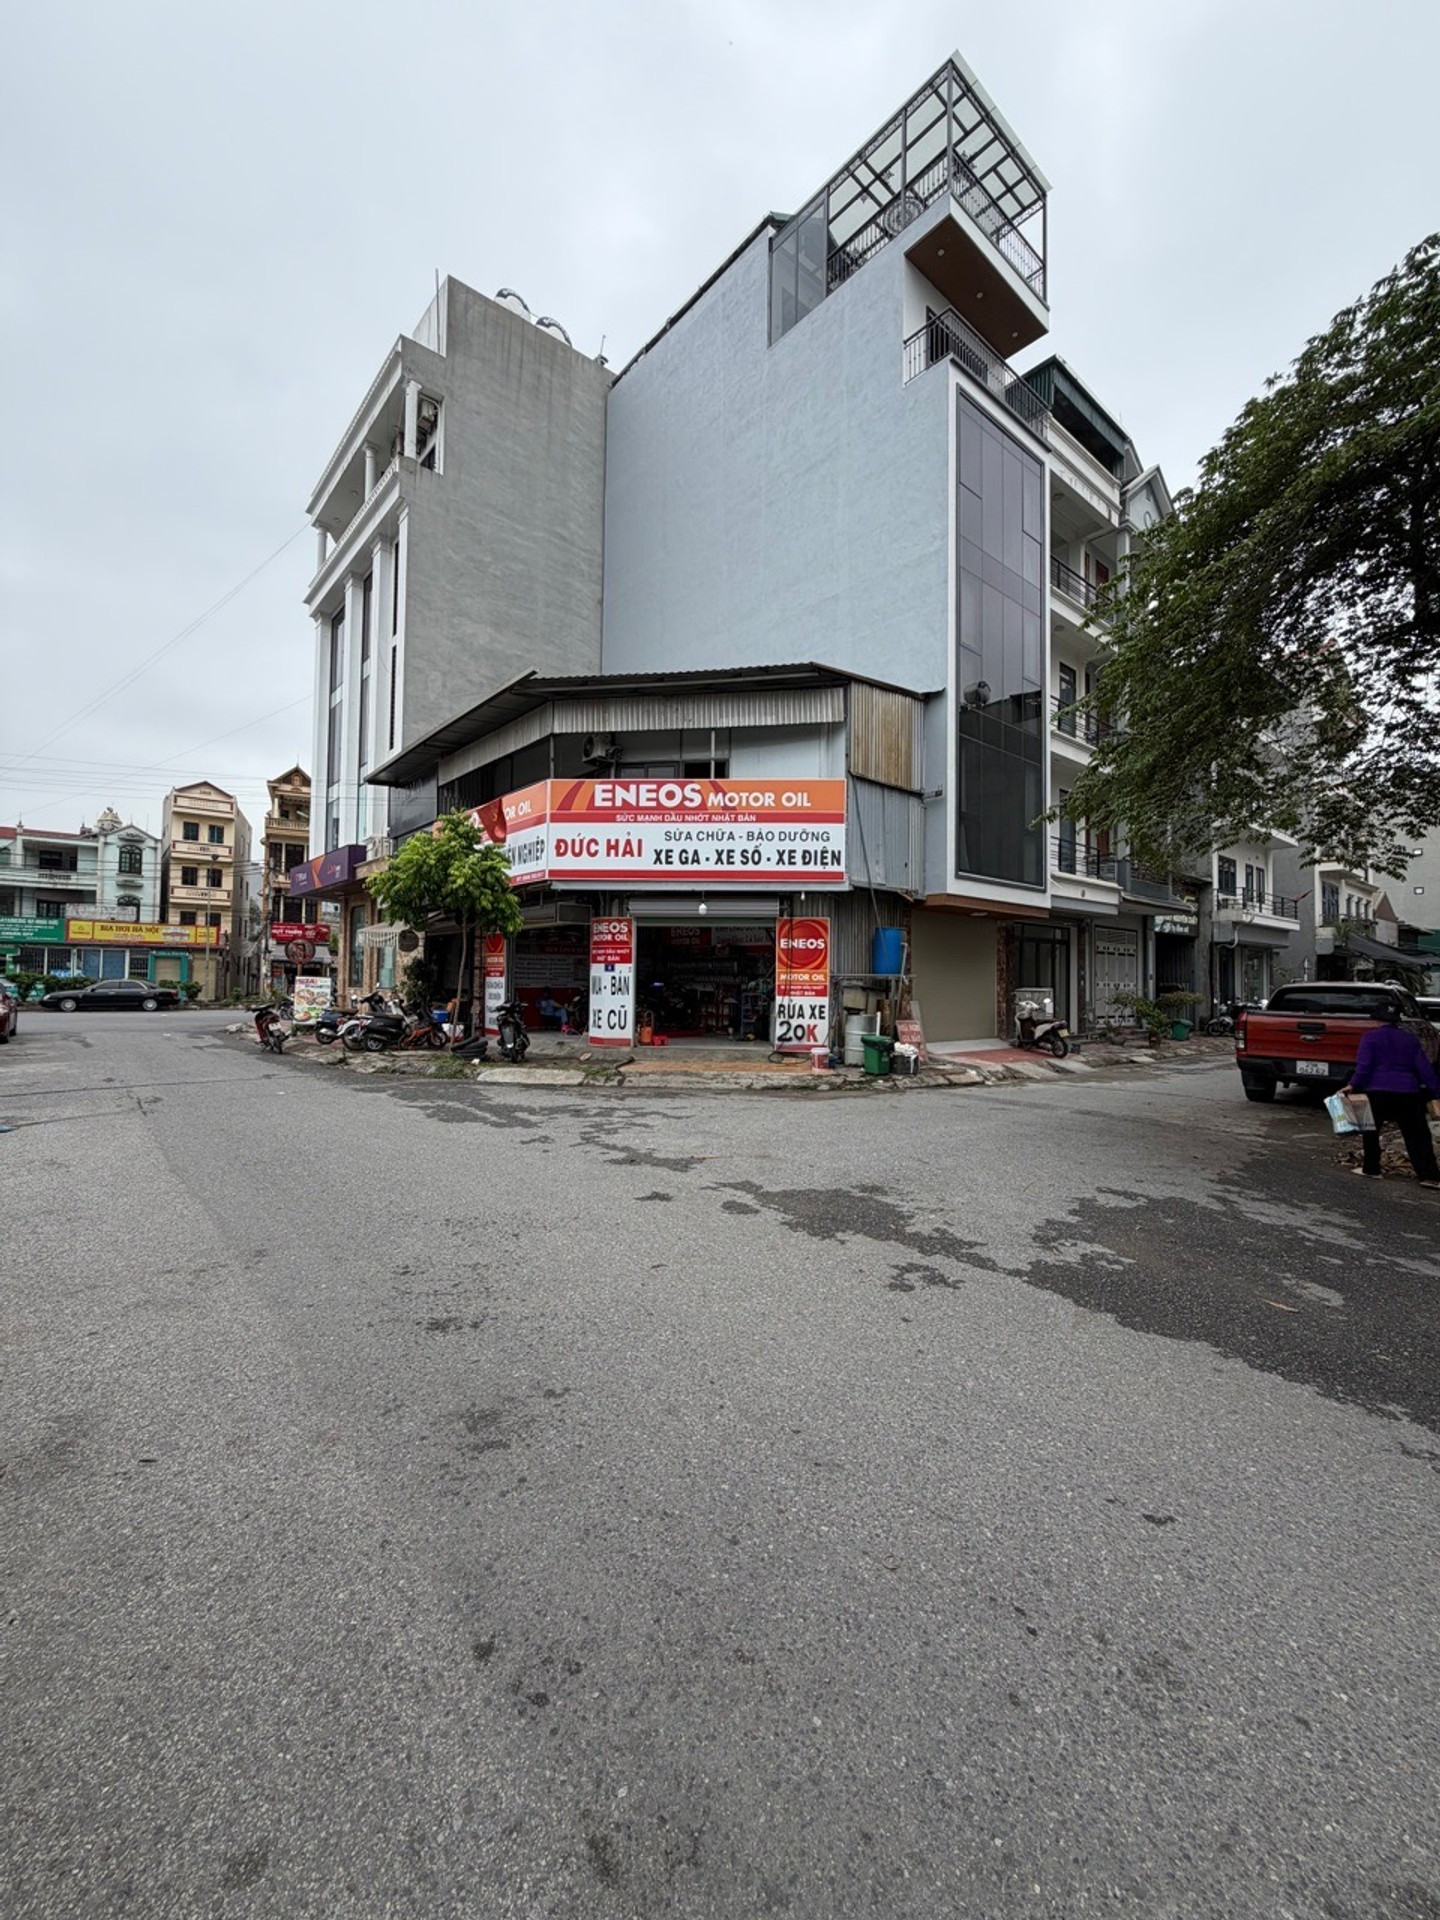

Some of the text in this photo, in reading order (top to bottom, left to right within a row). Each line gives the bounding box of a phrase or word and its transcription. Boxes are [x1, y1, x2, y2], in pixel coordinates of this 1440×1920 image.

[594, 783, 811, 808] ENEOS MOTOR OIL
[517, 799, 531, 816] OIL
[615, 811, 757, 823] SỨC MẠNH DẦU NHỚT NHẬT BẢN
[554, 831, 643, 858] ĐỨC HẢI
[664, 827, 831, 843] SỬA CHỮA BẢO DƯỠNG
[517, 835, 545, 867] NGHIỆP
[653, 843, 842, 869] XE GA XE SỐ XE ĐIỆN
[593, 922, 628, 933] ENEOS
[614, 933, 628, 941] OIL
[780, 938, 825, 949] ENEOS
[610, 970, 630, 996] BÁN
[780, 973, 825, 981] MOTOR OIL
[607, 1004, 627, 1030] CŨ
[778, 999, 826, 1020] RỬA XE
[776, 1020, 818, 1042] 20K
